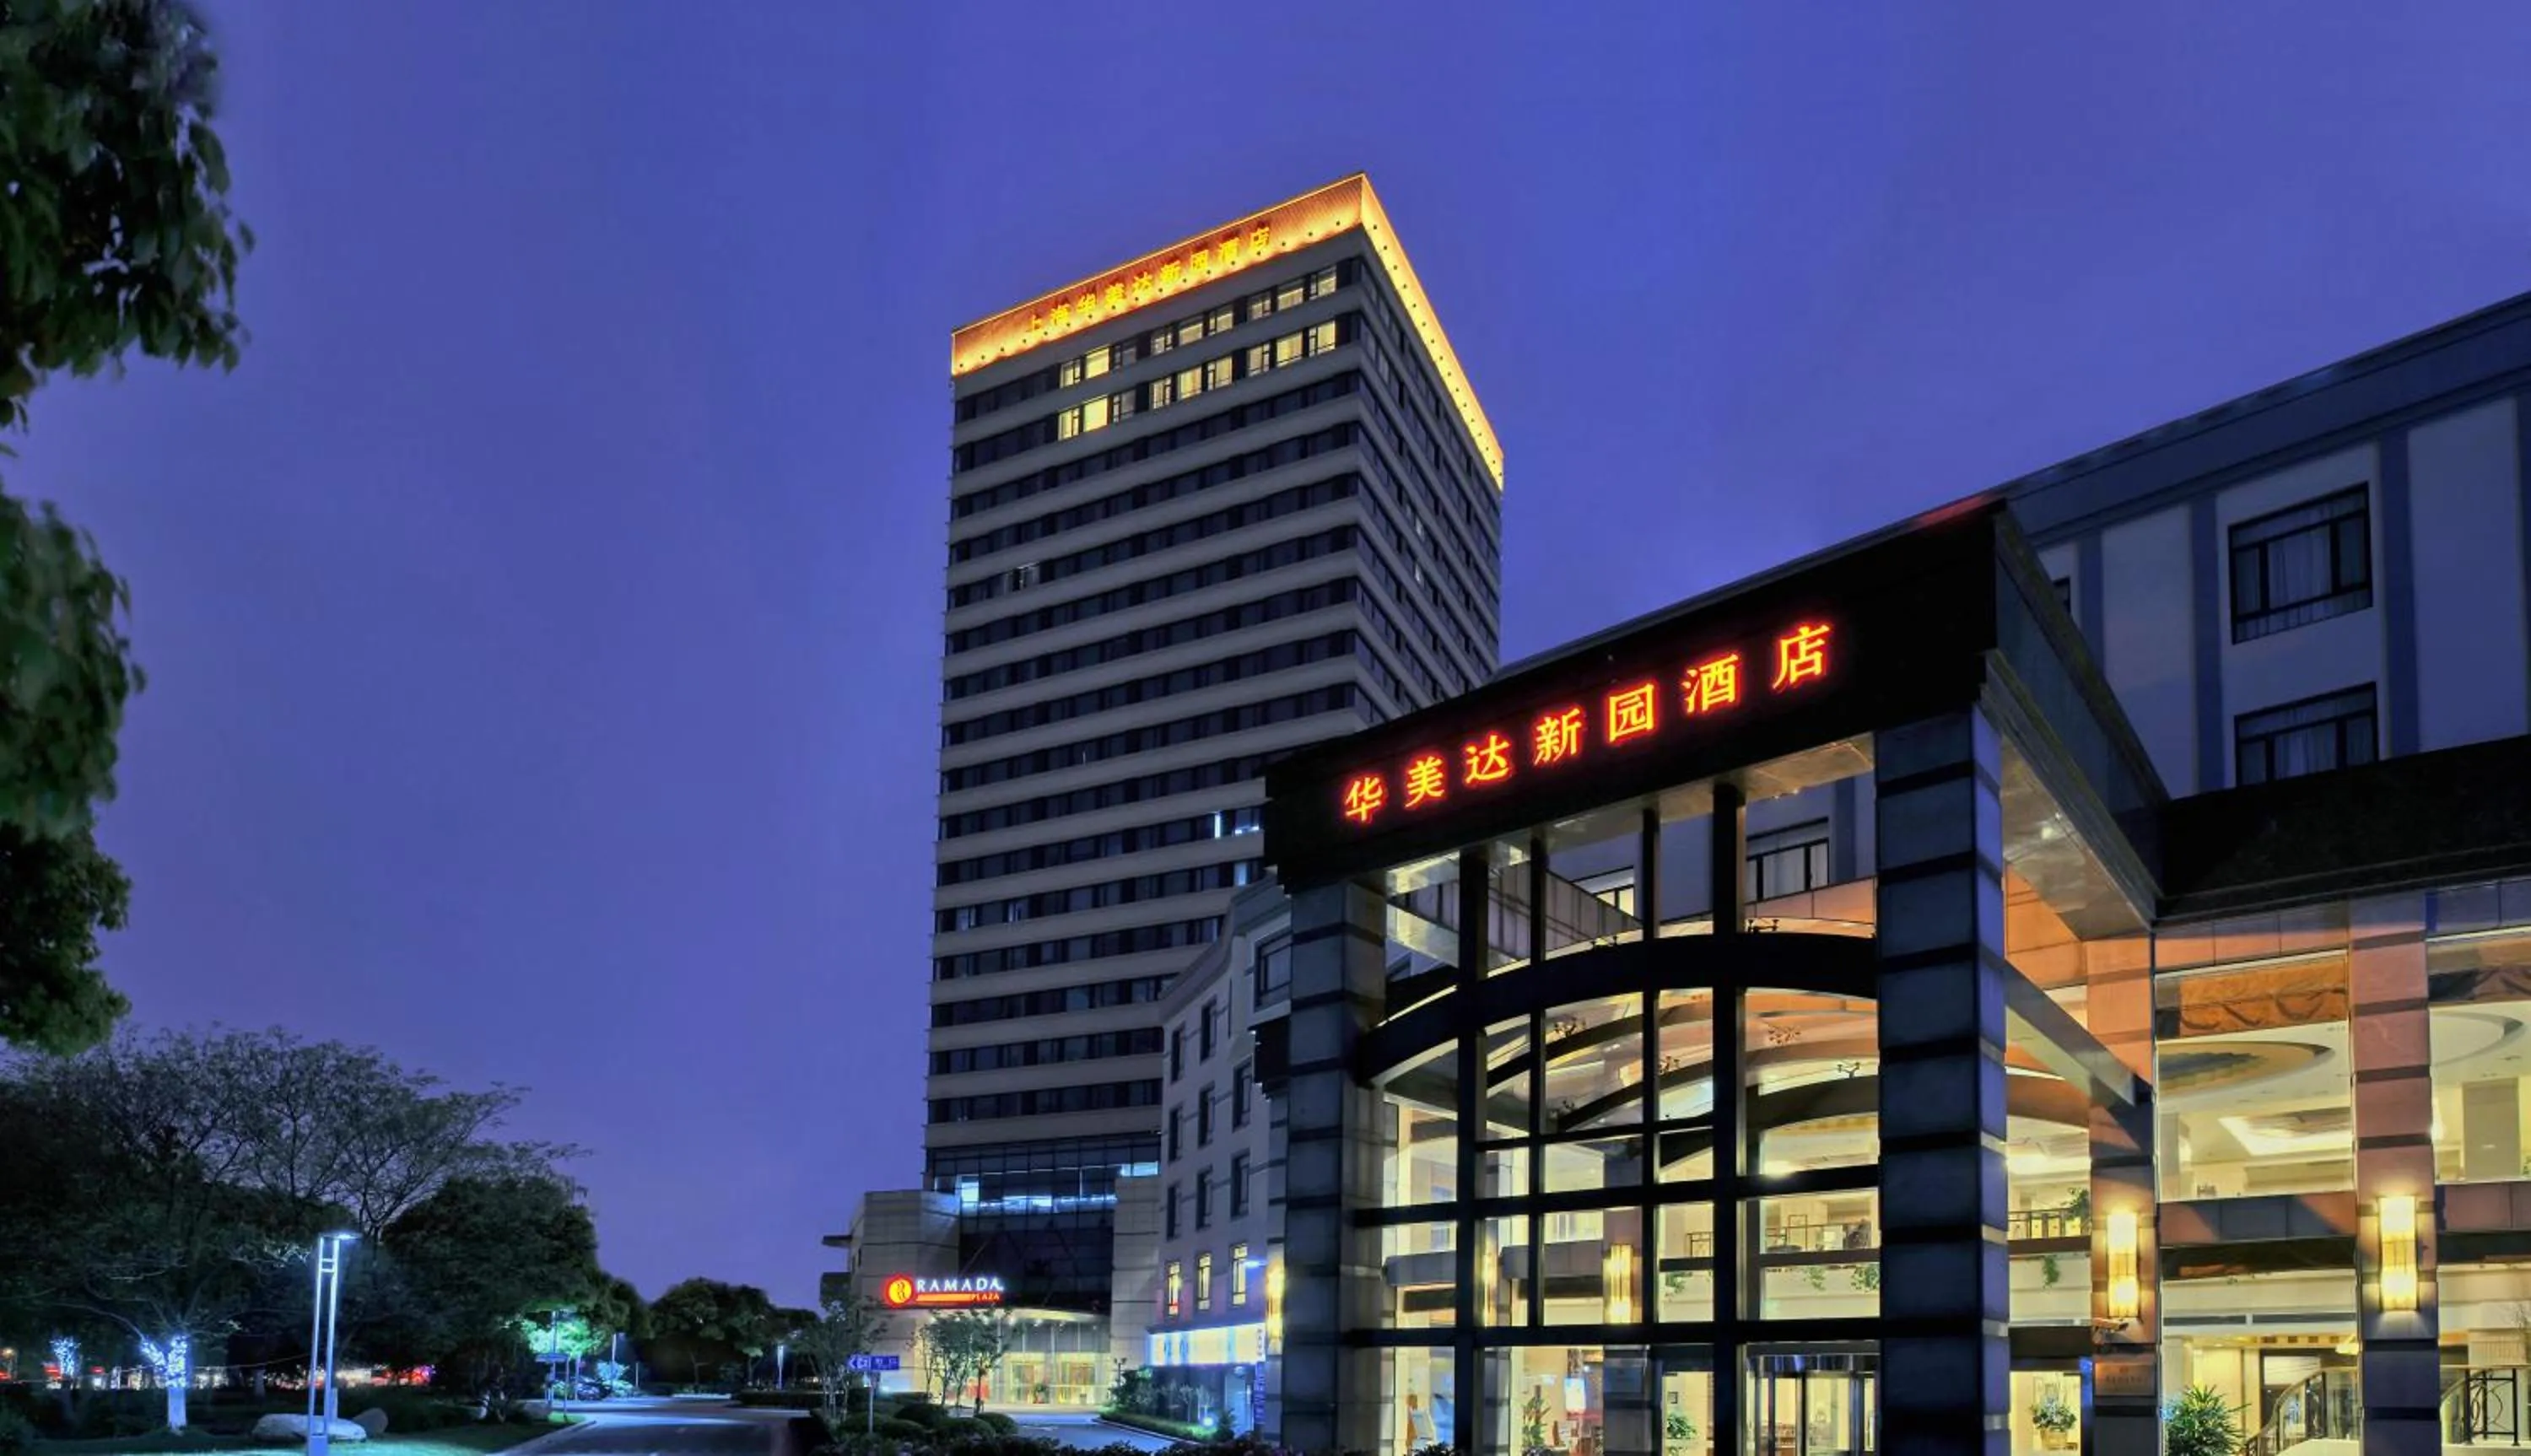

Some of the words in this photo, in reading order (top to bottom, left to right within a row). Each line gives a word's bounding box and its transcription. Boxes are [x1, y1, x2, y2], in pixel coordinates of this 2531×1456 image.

[1344, 623, 1831, 822] 华美达新园酒店
[916, 1277, 1003, 1292] RAMADA
[971, 1292, 1000, 1302] PLAZA
